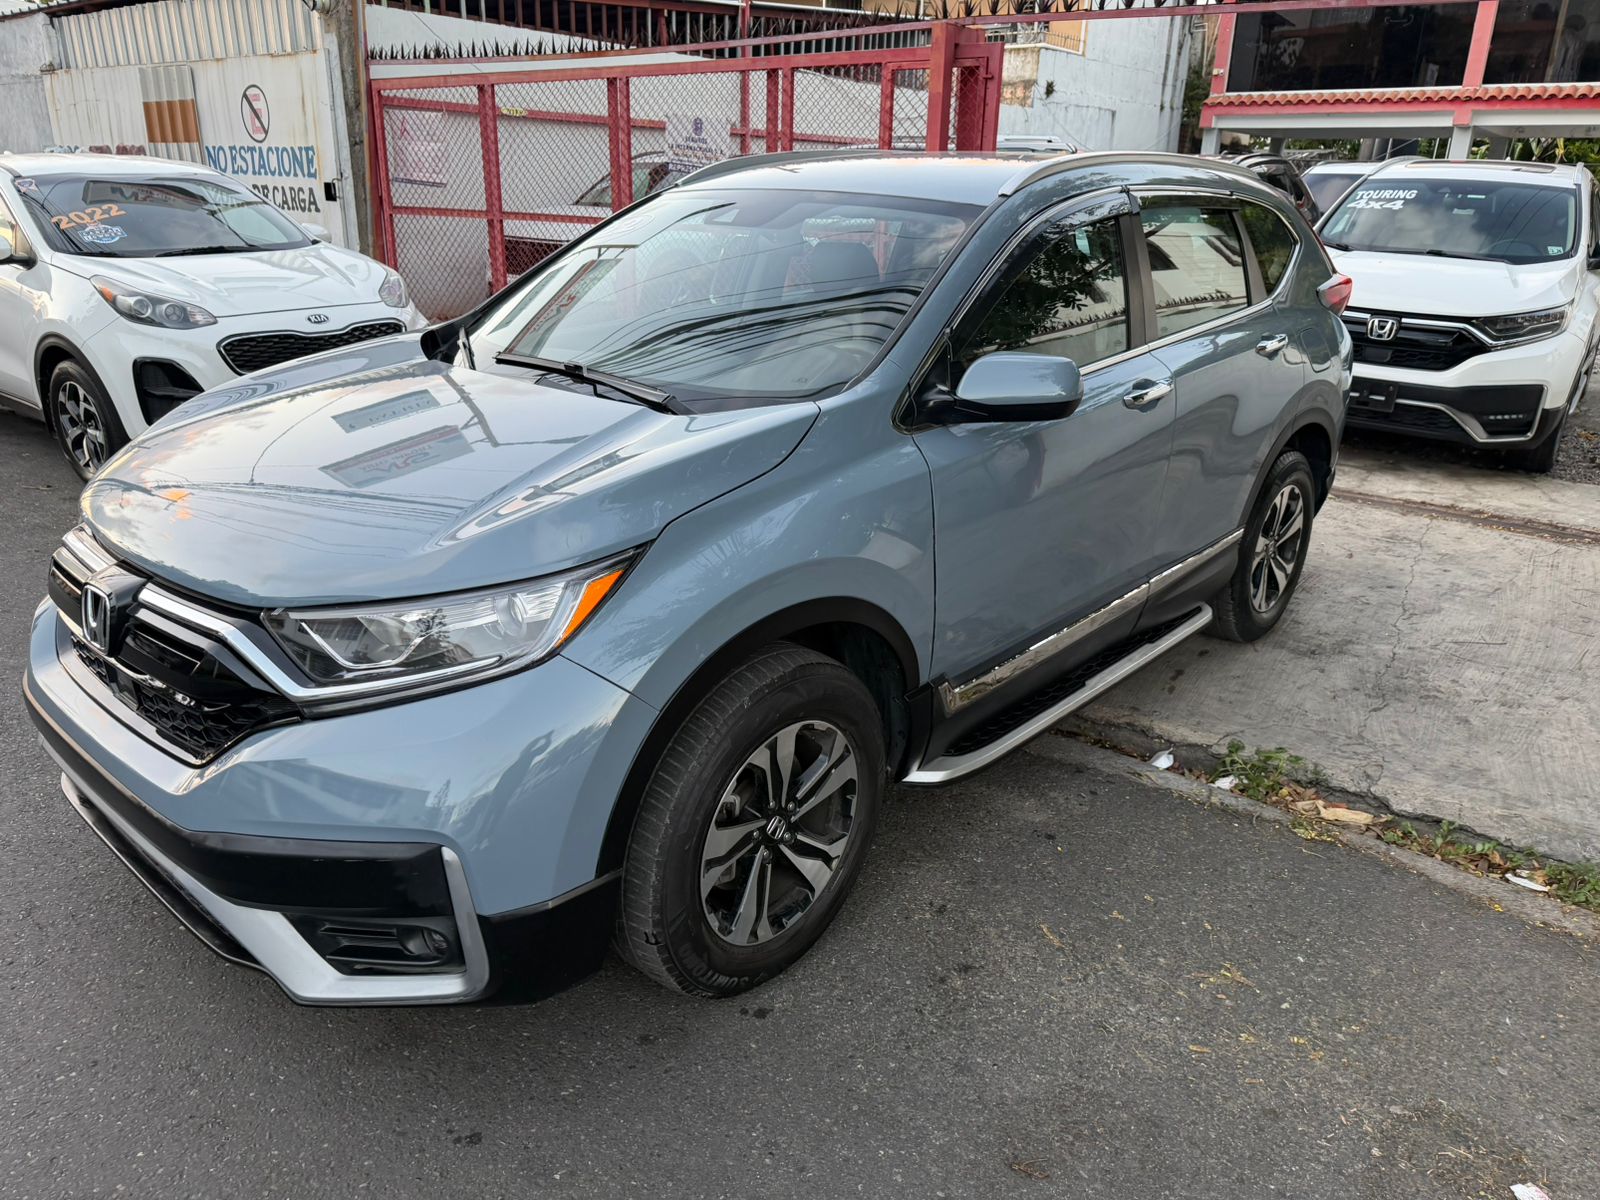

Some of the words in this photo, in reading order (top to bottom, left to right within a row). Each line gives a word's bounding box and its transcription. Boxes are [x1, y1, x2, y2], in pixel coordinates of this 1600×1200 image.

[205, 145, 228, 173] NO
[228, 145, 317, 179] ESTACIONE
[272, 185, 320, 213] CARGA
[1356, 189, 1418, 200] TOURING
[1347, 199, 1405, 210] 4x4
[51, 203, 127, 230] 2022
[308, 314, 329, 324] KIA
